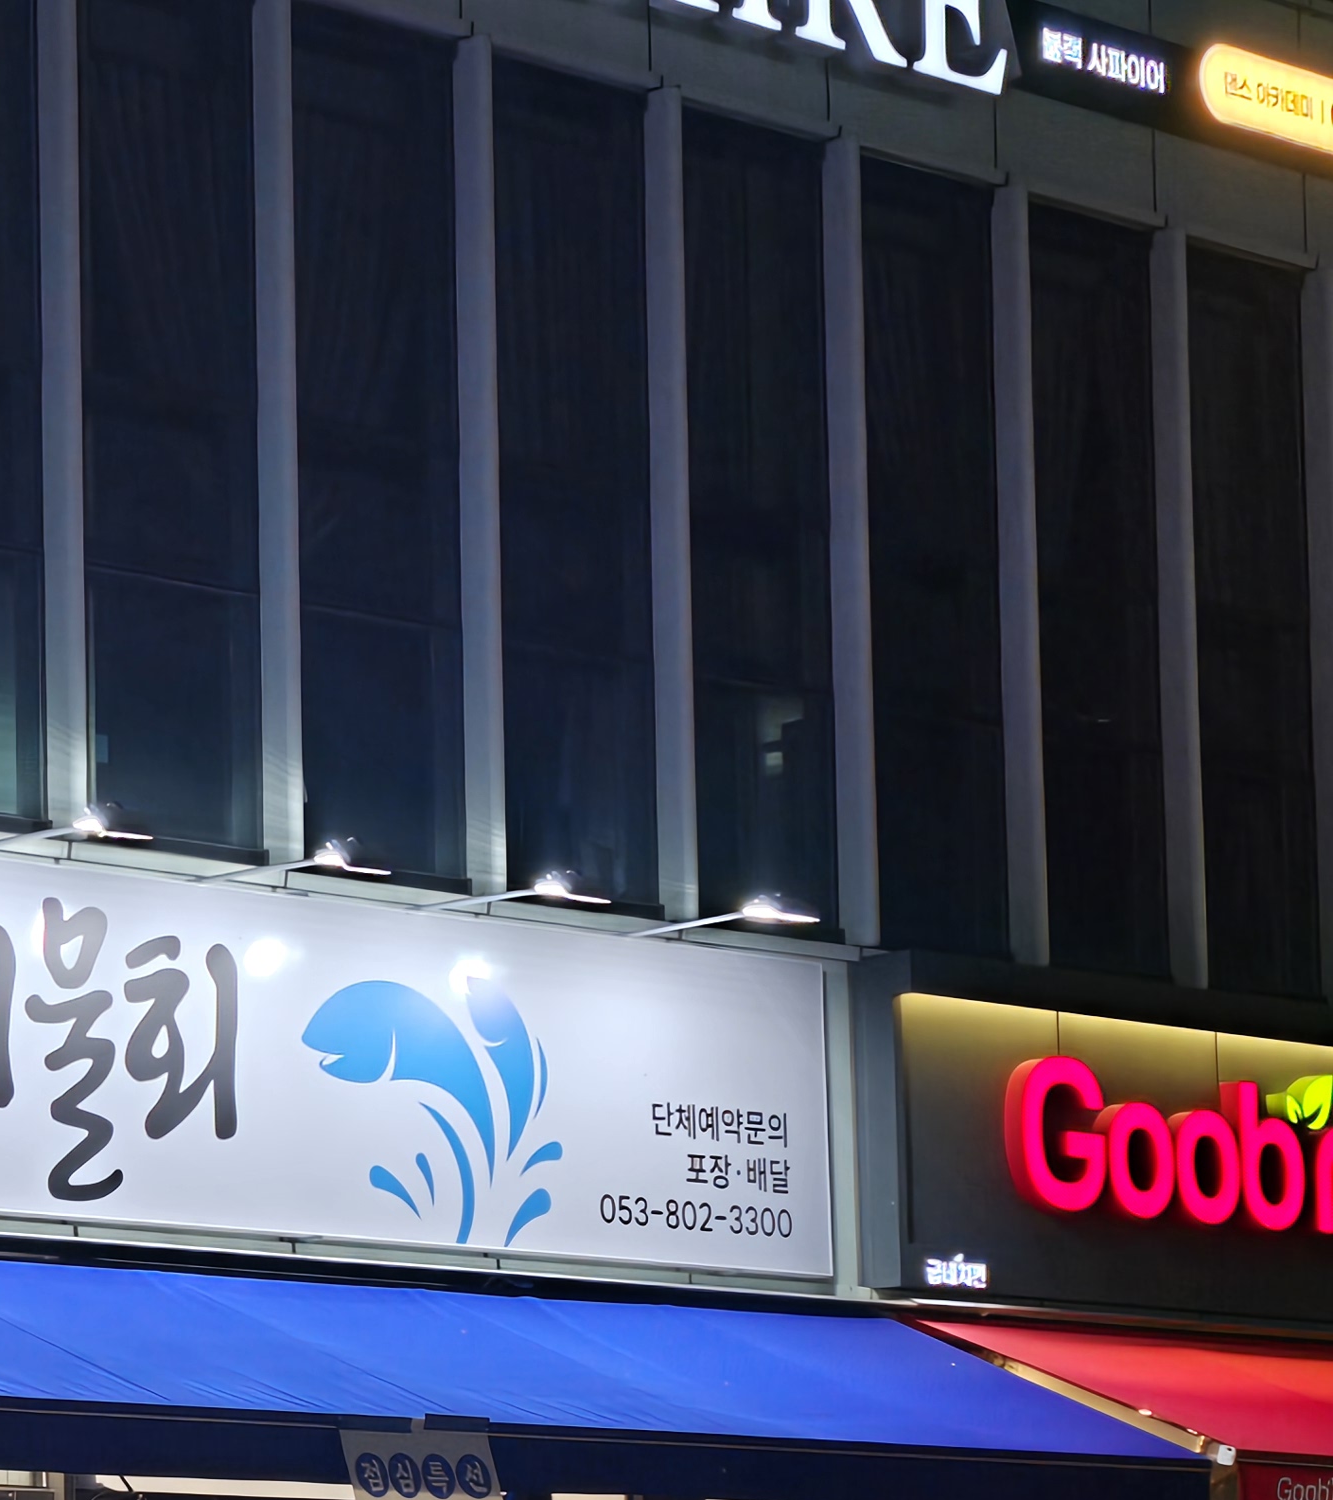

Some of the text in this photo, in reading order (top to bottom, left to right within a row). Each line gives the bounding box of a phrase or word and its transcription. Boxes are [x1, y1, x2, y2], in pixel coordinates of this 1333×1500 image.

[1087, 43, 1166, 94] 사파이어
[1257, 82, 1314, 120] 아카데미
[651, 1101, 789, 1149] 단체예약문의
[599, 1194, 793, 1239] 053-802-3300
[358, 1456, 490, 1497] 점심특선
